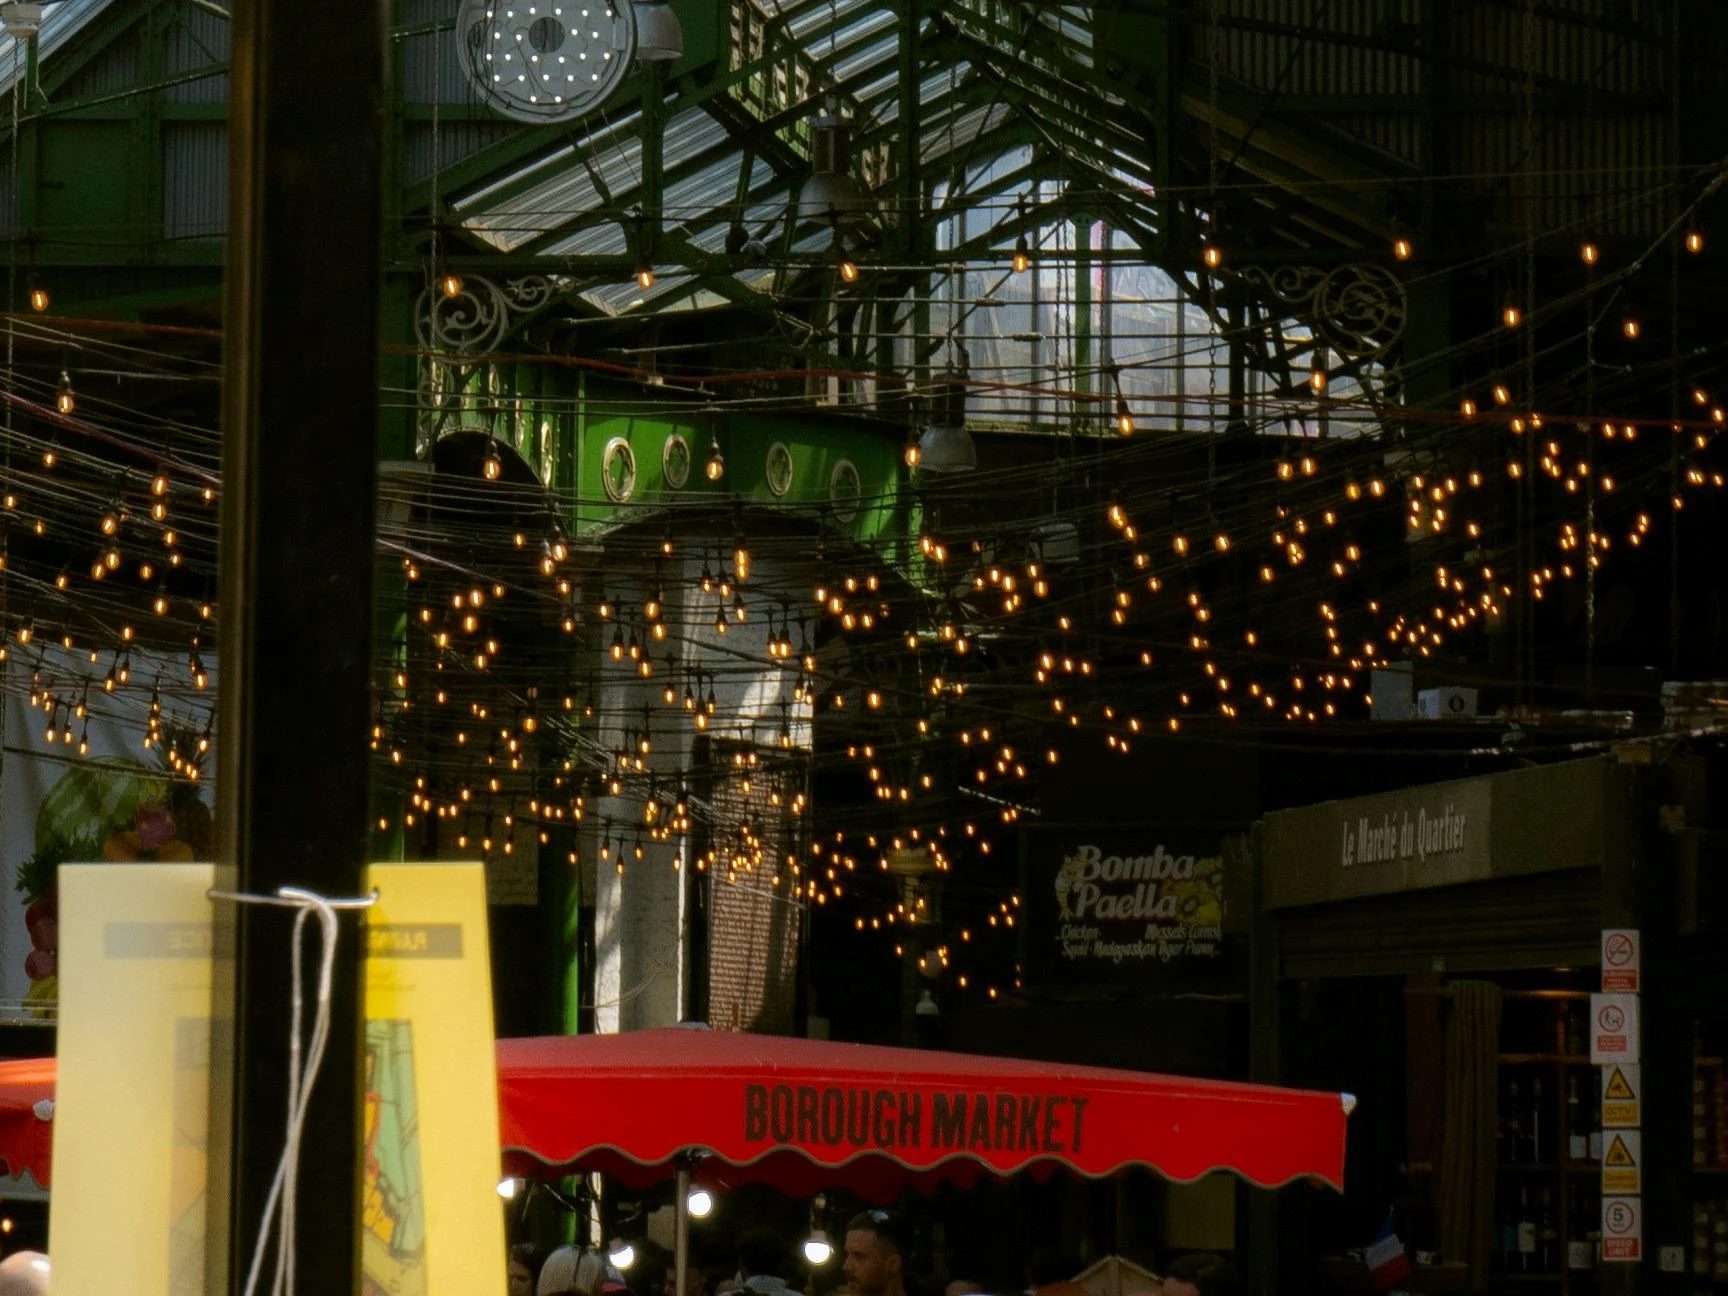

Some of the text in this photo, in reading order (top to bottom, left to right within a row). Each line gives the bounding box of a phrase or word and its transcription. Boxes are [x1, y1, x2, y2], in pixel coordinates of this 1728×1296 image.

[1342, 802, 1466, 867] Le Marché du Quartier
[1076, 844, 1195, 882] Bomba
[1074, 882, 1179, 920] Paella
[744, 1083, 1089, 1154] BOROUGH MARKET
[1613, 1209, 1623, 1222] 5
